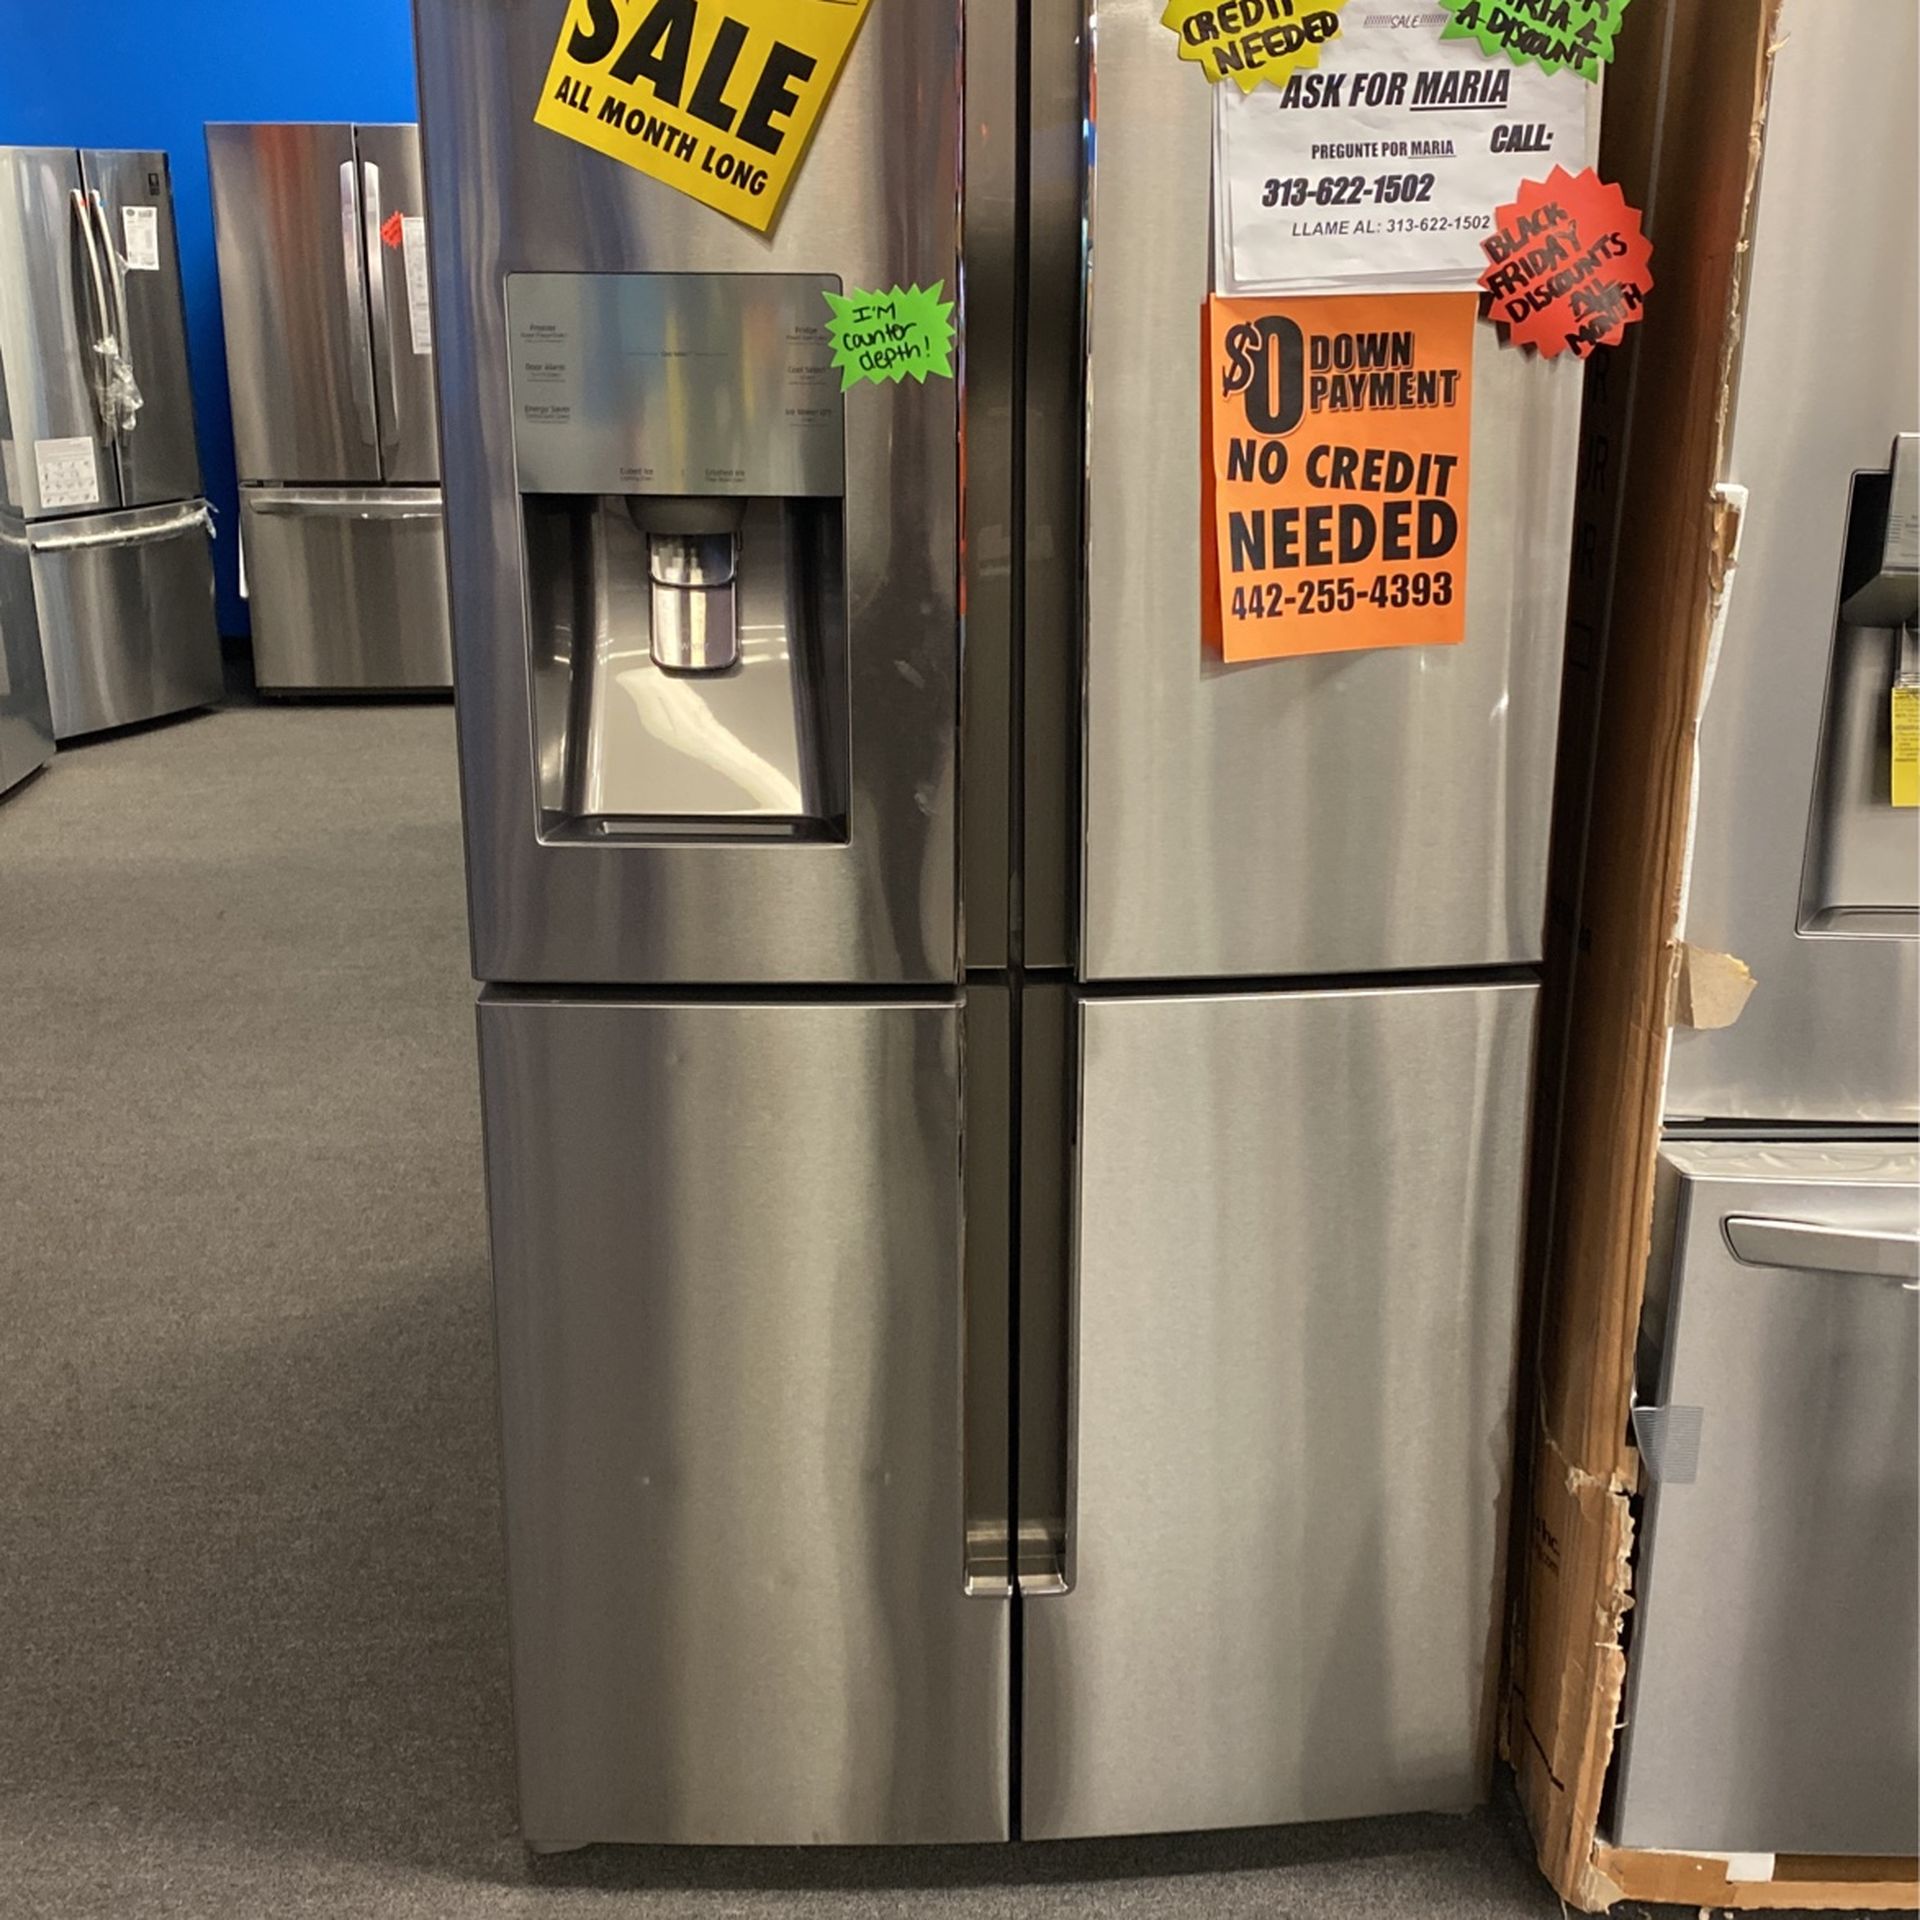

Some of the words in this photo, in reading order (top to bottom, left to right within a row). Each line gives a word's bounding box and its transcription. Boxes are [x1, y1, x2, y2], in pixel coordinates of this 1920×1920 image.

[1213, 11, 1339, 74] NEEDED
[1390, 14, 1420, 29] SALE
[1456, 1, 1486, 30] A
[1486, 7, 1598, 70] DISCOUNT
[1506, 0, 1572, 33] RIA
[566, 0, 817, 155] SALE
[1280, 72, 1347, 109] ASK
[1348, 71, 1408, 107] FOR
[1410, 69, 1511, 105] MARIA
[555, 75, 594, 114] ALL
[597, 96, 699, 163] MONTH
[701, 145, 769, 196] LONG
[1311, 141, 1379, 160] PREGUNTE
[1381, 140, 1408, 157] POR
[1410, 139, 1454, 156] MARIA
[1261, 173, 1437, 208] 313-622-1502
[1292, 220, 1350, 236] LLAME
[1353, 219, 1381, 234] AL:
[1386, 215, 1491, 233] 313-622-1502
[1484, 202, 1569, 265] BLACK
[1486, 219, 1582, 300] FRIDAY
[1505, 232, 1628, 324] DISCOUNTS
[852, 302, 896, 323] I'M
[1564, 282, 1643, 356] MONTH
[1568, 278, 1621, 323] ALL
[858, 335, 931, 371] depth!
[1222, 315, 1304, 436] $0
[1309, 331, 1415, 372] DOWN
[1309, 369, 1460, 411] PAYMENT
[1227, 438, 1289, 484] NO
[1305, 443, 1459, 497] CREDIT
[1229, 498, 1459, 573] NEEDED
[1231, 571, 1452, 621] 442-255-4393
